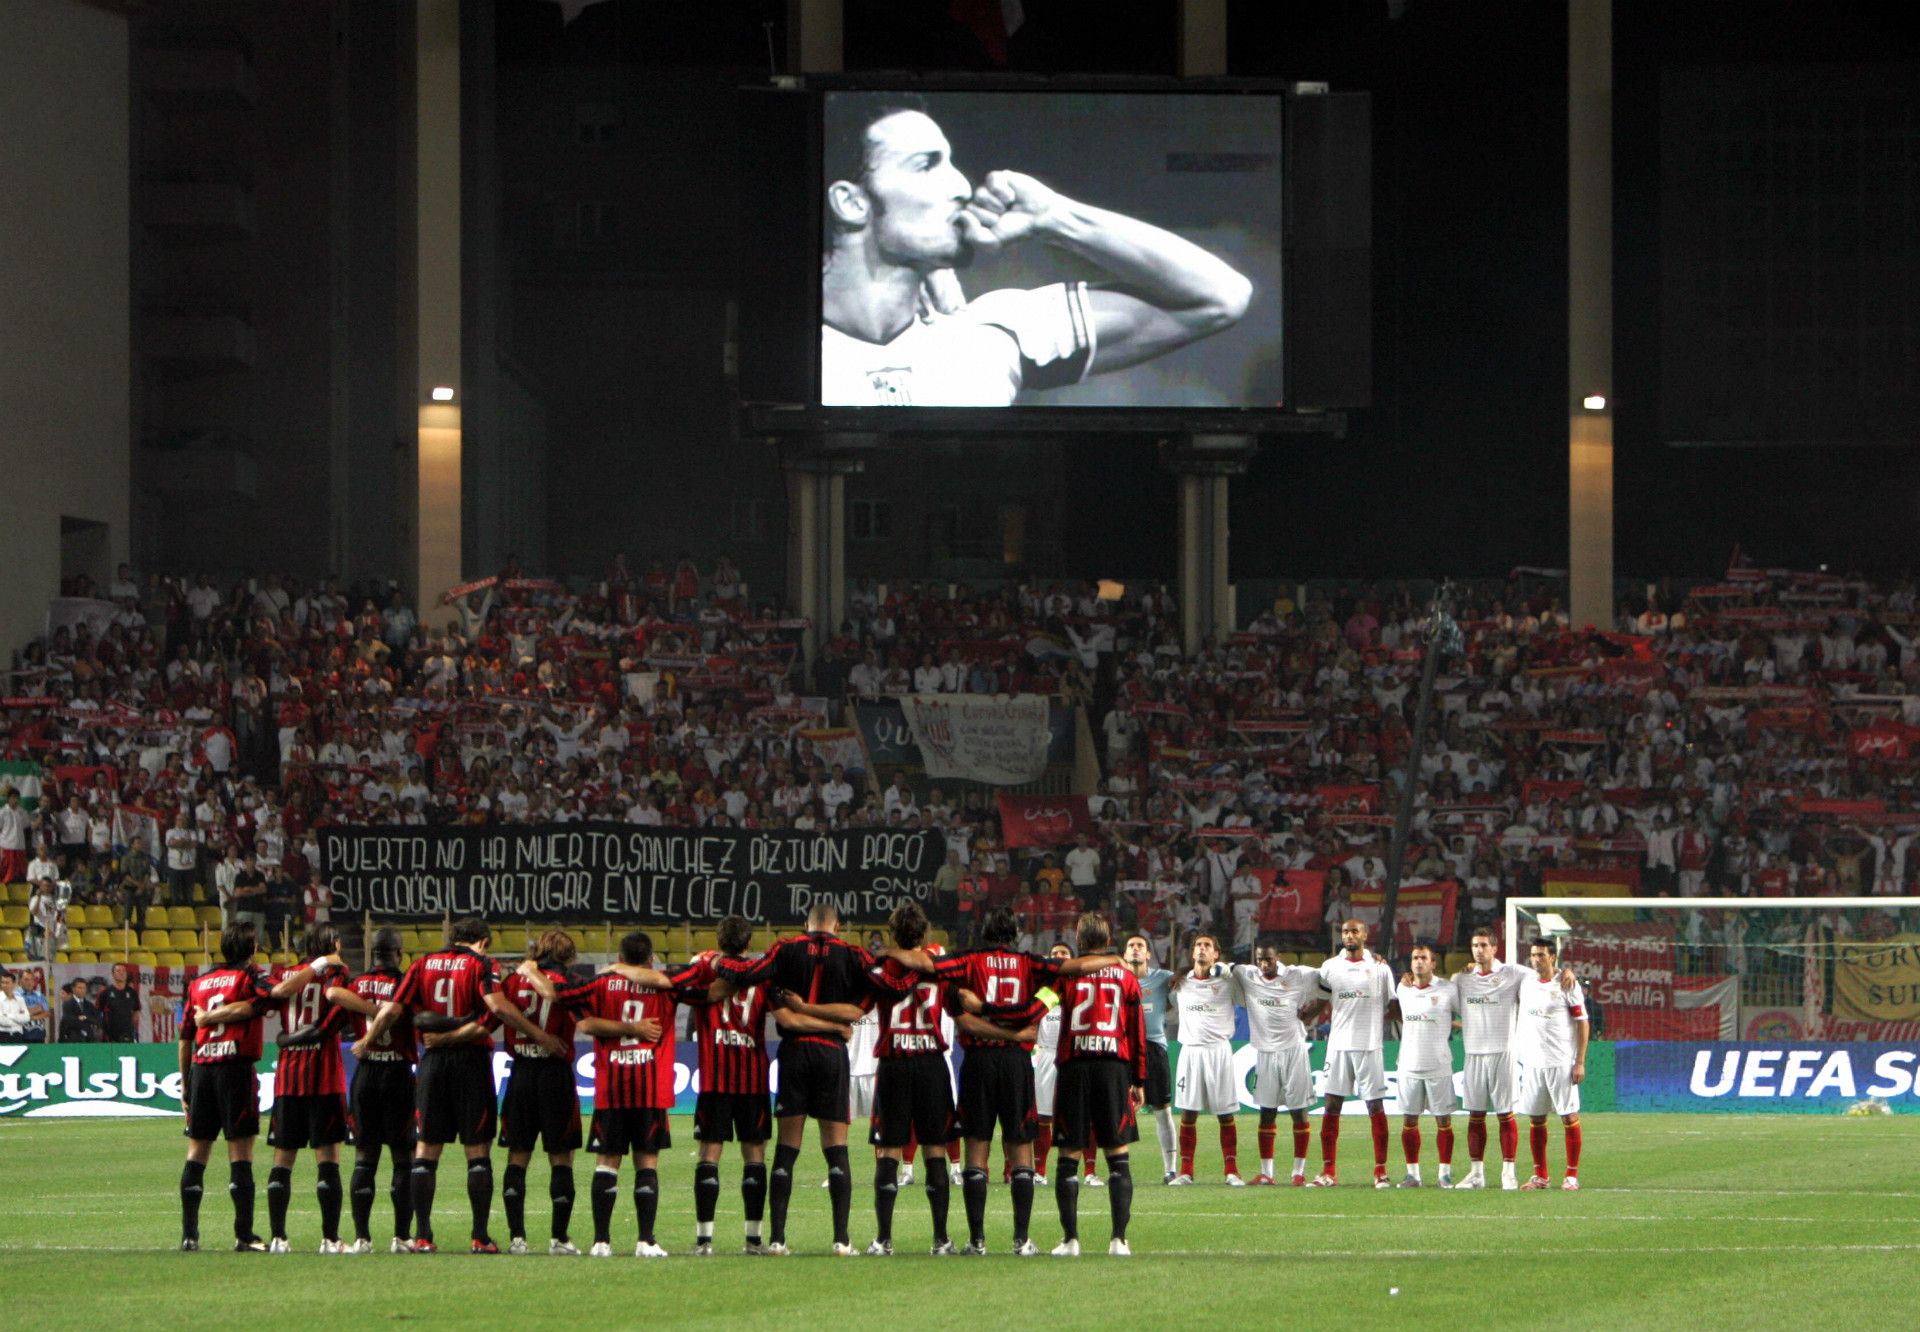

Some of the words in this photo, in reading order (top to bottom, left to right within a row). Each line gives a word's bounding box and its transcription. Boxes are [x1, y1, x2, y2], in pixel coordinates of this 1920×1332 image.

[328, 835, 428, 872] PUERTA
[436, 838, 465, 871] NO
[481, 836, 506, 871] HA
[330, 875, 362, 912] SU
[603, 872, 641, 914] EN
[651, 875, 682, 918] EL
[787, 883, 858, 917] TRIANA
[288, 983, 321, 1036] 18
[434, 978, 455, 1018] 4
[890, 982, 939, 1030] 22
[1071, 982, 1122, 1032] 23
[610, 1048, 653, 1065] PUERTA
[893, 1033, 938, 1050] PUERTA
[1073, 1035, 1118, 1053] PUERTA
[1690, 1050, 1856, 1097] UEFA
[1866, 1050, 1920, 1098] S
